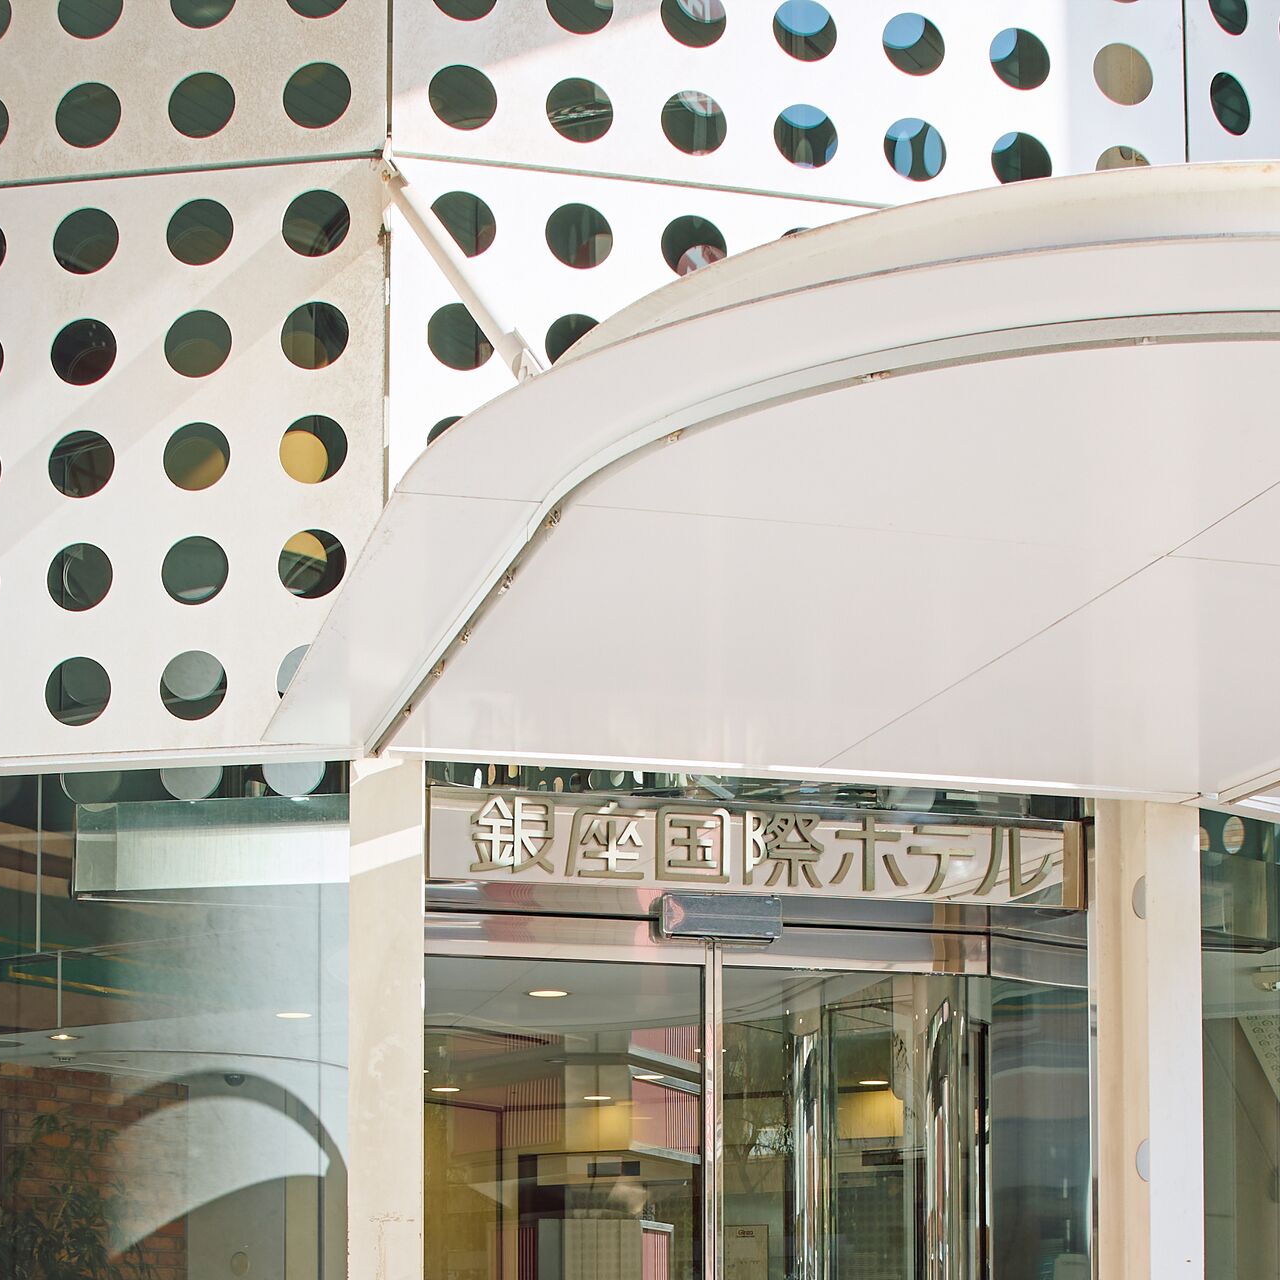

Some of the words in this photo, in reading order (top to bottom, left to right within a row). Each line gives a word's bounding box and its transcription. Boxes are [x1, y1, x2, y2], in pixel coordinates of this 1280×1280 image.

[469, 795, 1052, 897] 銀座国際ホテル
